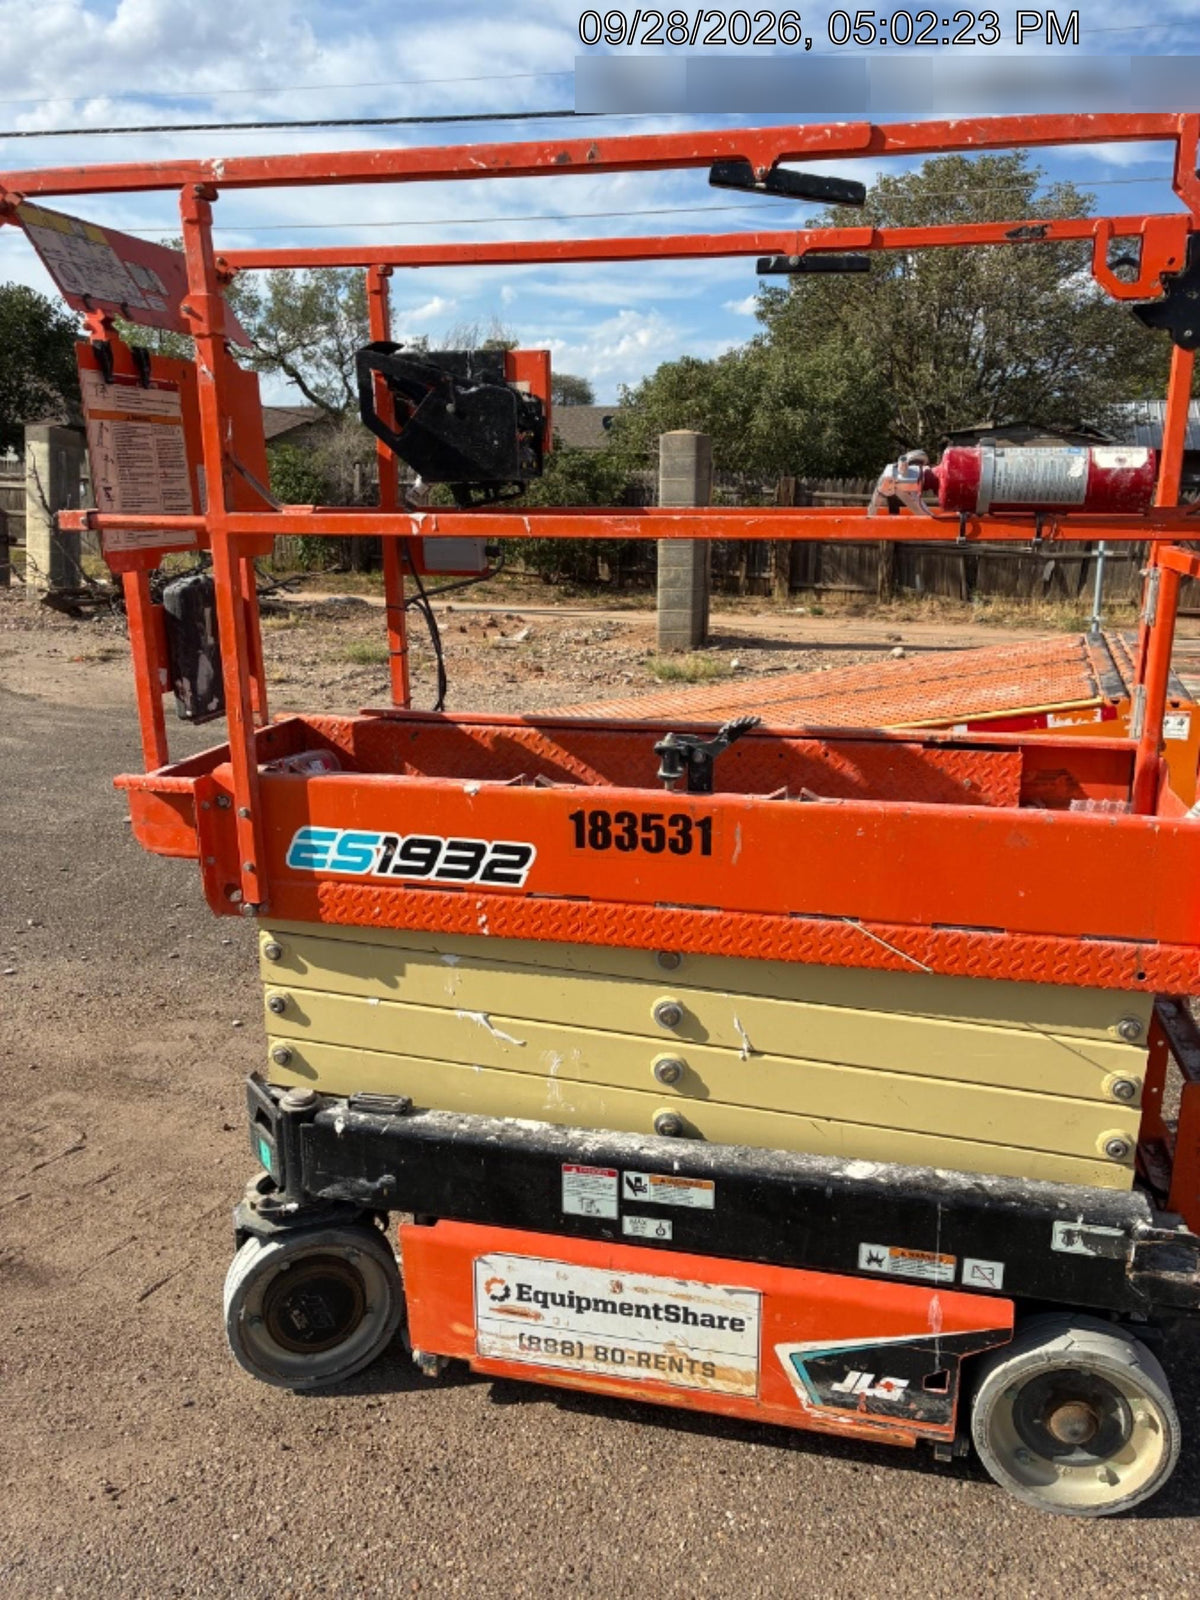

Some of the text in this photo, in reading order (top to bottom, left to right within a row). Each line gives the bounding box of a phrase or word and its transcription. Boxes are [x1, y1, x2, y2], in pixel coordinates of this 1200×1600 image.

[568, 809, 713, 856] 183531
[287, 826, 536, 887] ES1932
[515, 1282, 746, 1333] EquipmentShare
[518, 1332, 716, 1379] (888) 80-RENTS
[830, 1370, 910, 1401] JLG
